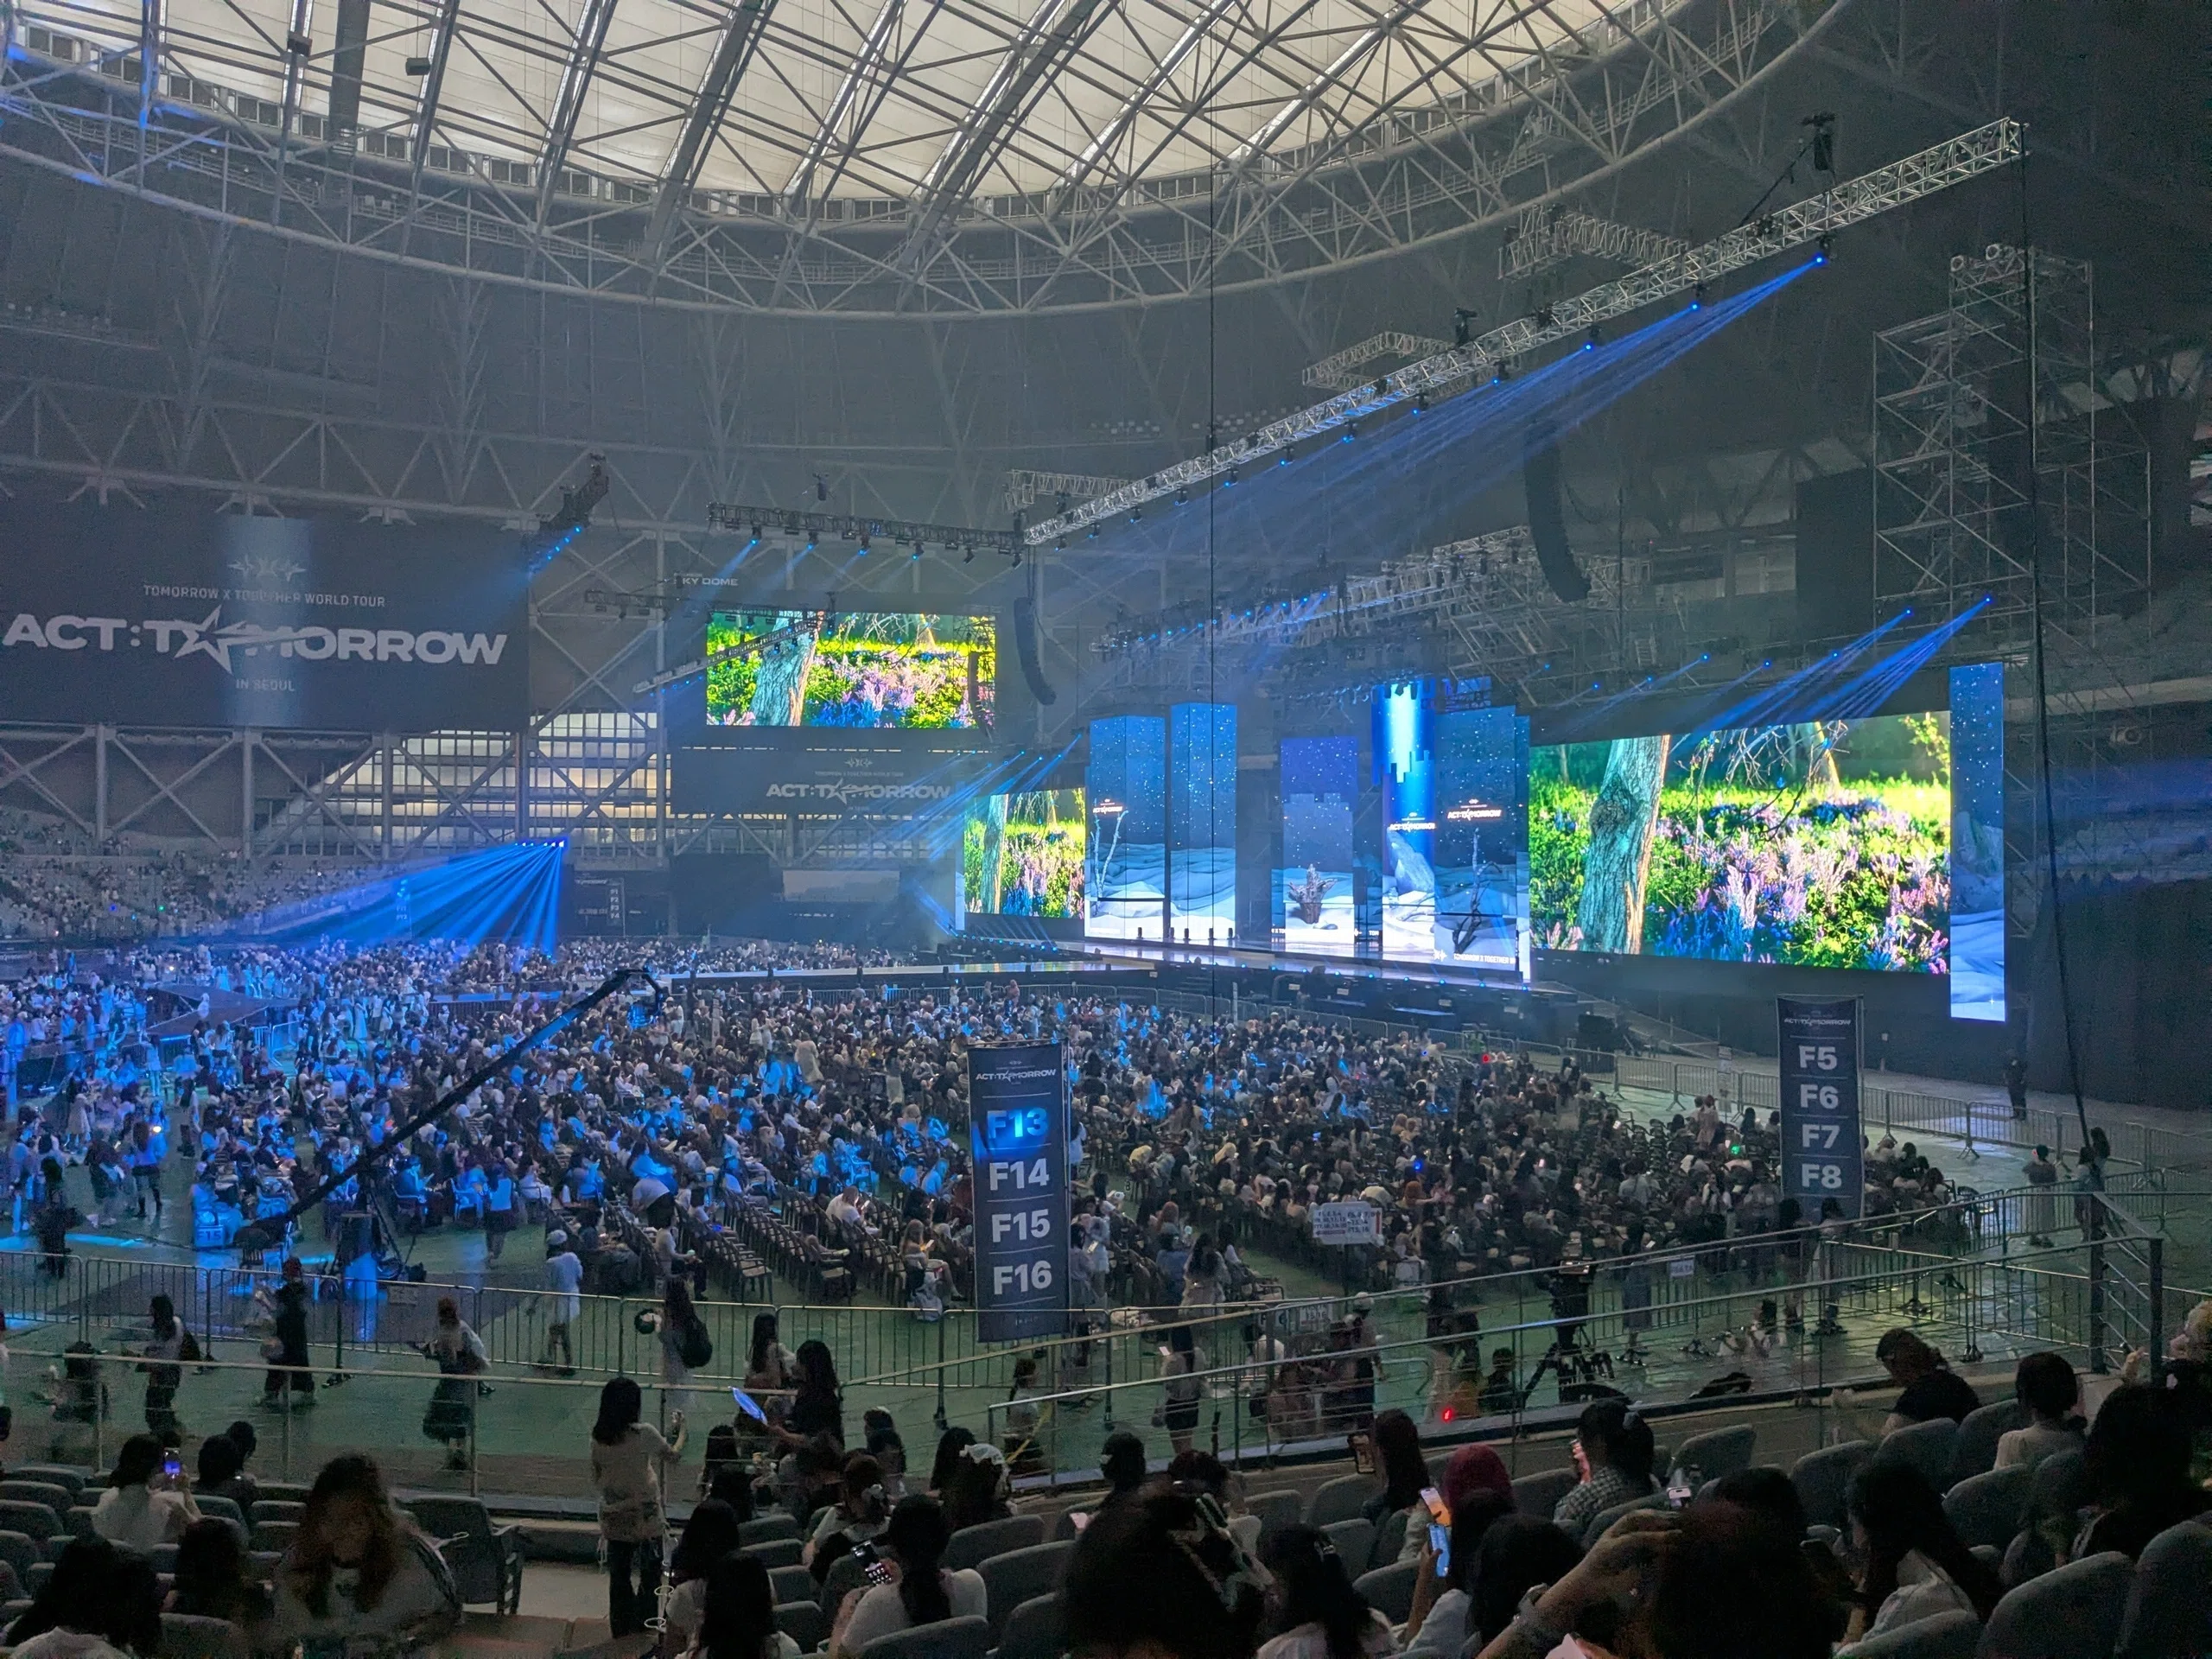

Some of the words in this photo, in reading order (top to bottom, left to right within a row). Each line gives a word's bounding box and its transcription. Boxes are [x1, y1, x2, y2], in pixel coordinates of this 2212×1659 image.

[702, 577, 739, 586] DOME
[143, 585, 218, 599] TOMORROW
[223, 589, 231, 600] X
[305, 593, 349, 606] WORLD
[353, 595, 385, 607] TOUR
[236, 679, 249, 690] IN
[1798, 1046, 1837, 1070] F5
[1800, 1084, 1839, 1109] F6
[987, 1107, 1047, 1140] F13
[1802, 1124, 1840, 1149] F7
[988, 1158, 1051, 1191] F14
[1802, 1163, 1842, 1189] F8
[991, 1209, 1052, 1243] F15
[993, 1260, 1052, 1295] F16
